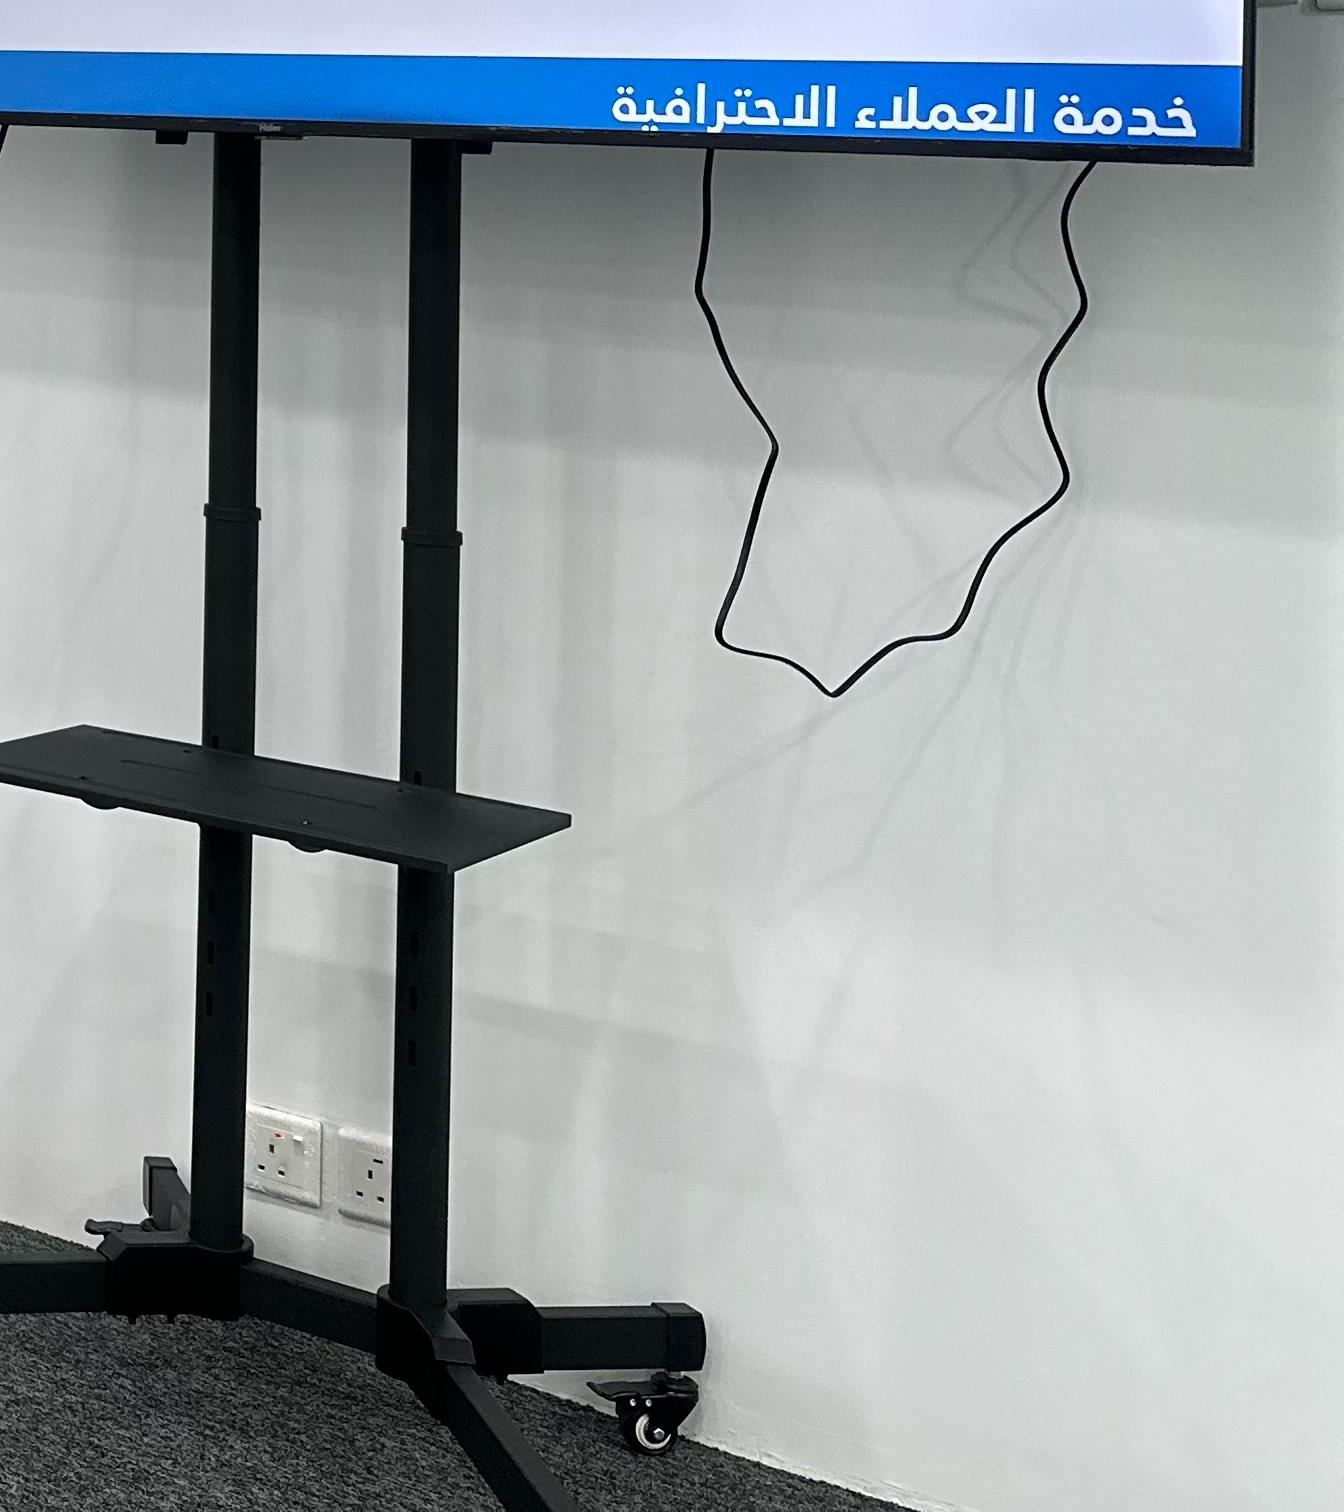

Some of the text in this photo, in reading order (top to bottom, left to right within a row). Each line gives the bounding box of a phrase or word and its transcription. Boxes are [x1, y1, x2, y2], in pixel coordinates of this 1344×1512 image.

[612, 82, 1196, 137] خدمة العملاء الاحترافية
